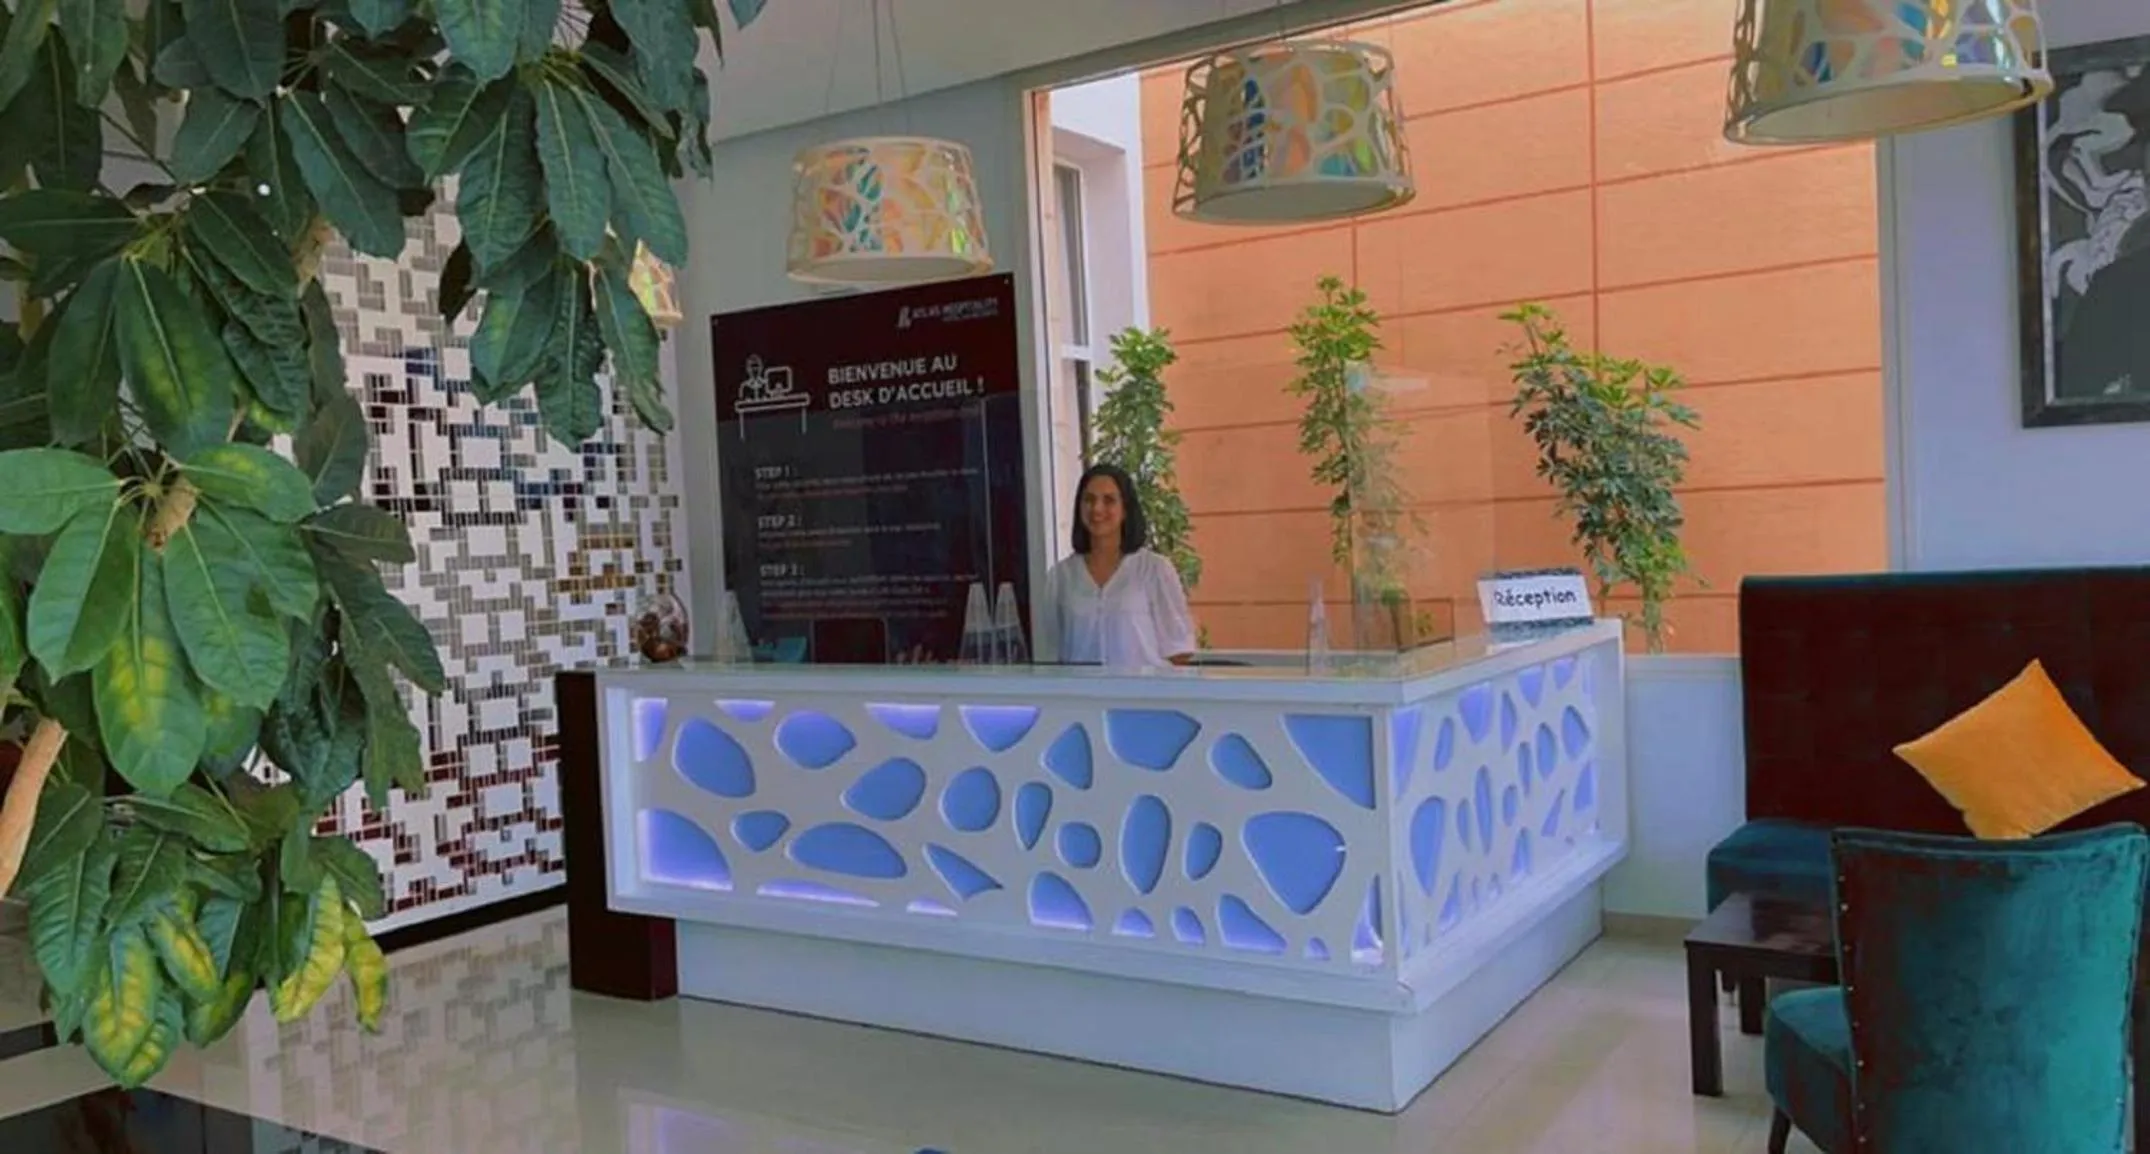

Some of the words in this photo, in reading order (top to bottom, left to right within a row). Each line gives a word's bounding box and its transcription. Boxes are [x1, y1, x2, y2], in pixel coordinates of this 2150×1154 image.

[828, 358, 927, 385] BIENVENUE
[931, 353, 958, 373] AU
[828, 387, 875, 409] DESK
[878, 378, 973, 404] D'ACCUEIL
[755, 466, 782, 480] STEP
[757, 515, 786, 529] STEP
[759, 563, 787, 577] STEP
[1493, 587, 1577, 609] Réception
